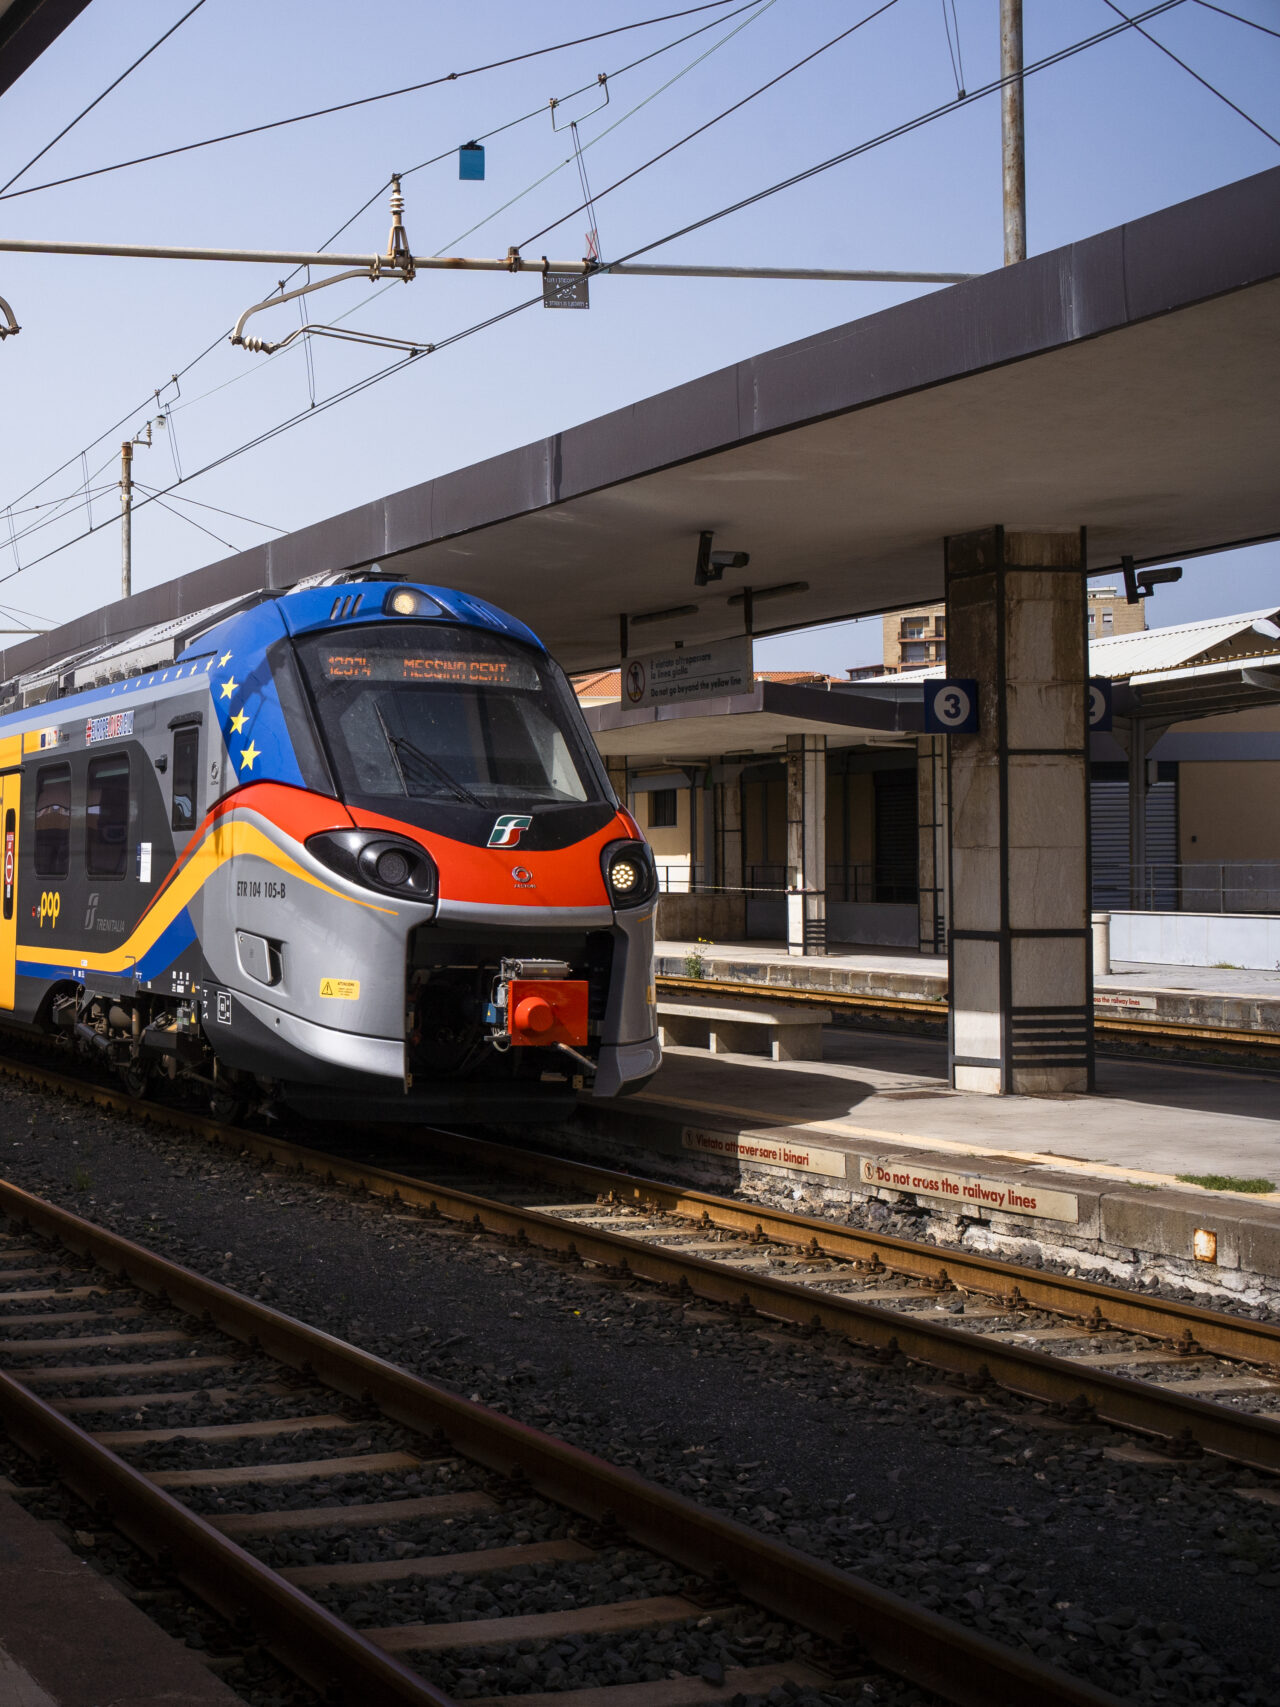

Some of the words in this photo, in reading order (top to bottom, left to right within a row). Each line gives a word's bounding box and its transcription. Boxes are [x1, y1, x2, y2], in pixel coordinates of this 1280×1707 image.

[656, 658, 674, 669] vietato
[675, 653, 711, 666] oltrepassare
[650, 671, 656, 680] la
[657, 669, 671, 679] linea
[672, 666, 689, 678] gialla
[650, 688, 659, 697] Do
[659, 687, 669, 696] not
[669, 687, 677, 697] go
[678, 681, 699, 695] beyond
[700, 680, 710, 690] the
[710, 677, 730, 692] yellow
[730, 675, 742, 686] line
[943, 694, 962, 719] 3
[236, 880, 248, 897] ETR
[249, 881, 261, 898] 104
[264, 882, 286, 899] 105-B
[39, 891, 61, 929] pop
[96, 917, 126, 933] TRENITALIA
[1111, 997, 1128, 1006] railway
[1128, 998, 1140, 1006] lines
[695, 1133, 723, 1151] Vietato
[724, 1139, 777, 1163] attraversare
[778, 1149, 782, 1164] i
[782, 1148, 810, 1166] binari
[876, 1166, 891, 1182] Do
[892, 1170, 911, 1186] not
[912, 1176, 940, 1192] cross
[941, 1175, 960, 1195] the
[962, 1182, 1006, 1207] railway
[1007, 1188, 1037, 1210] lines
